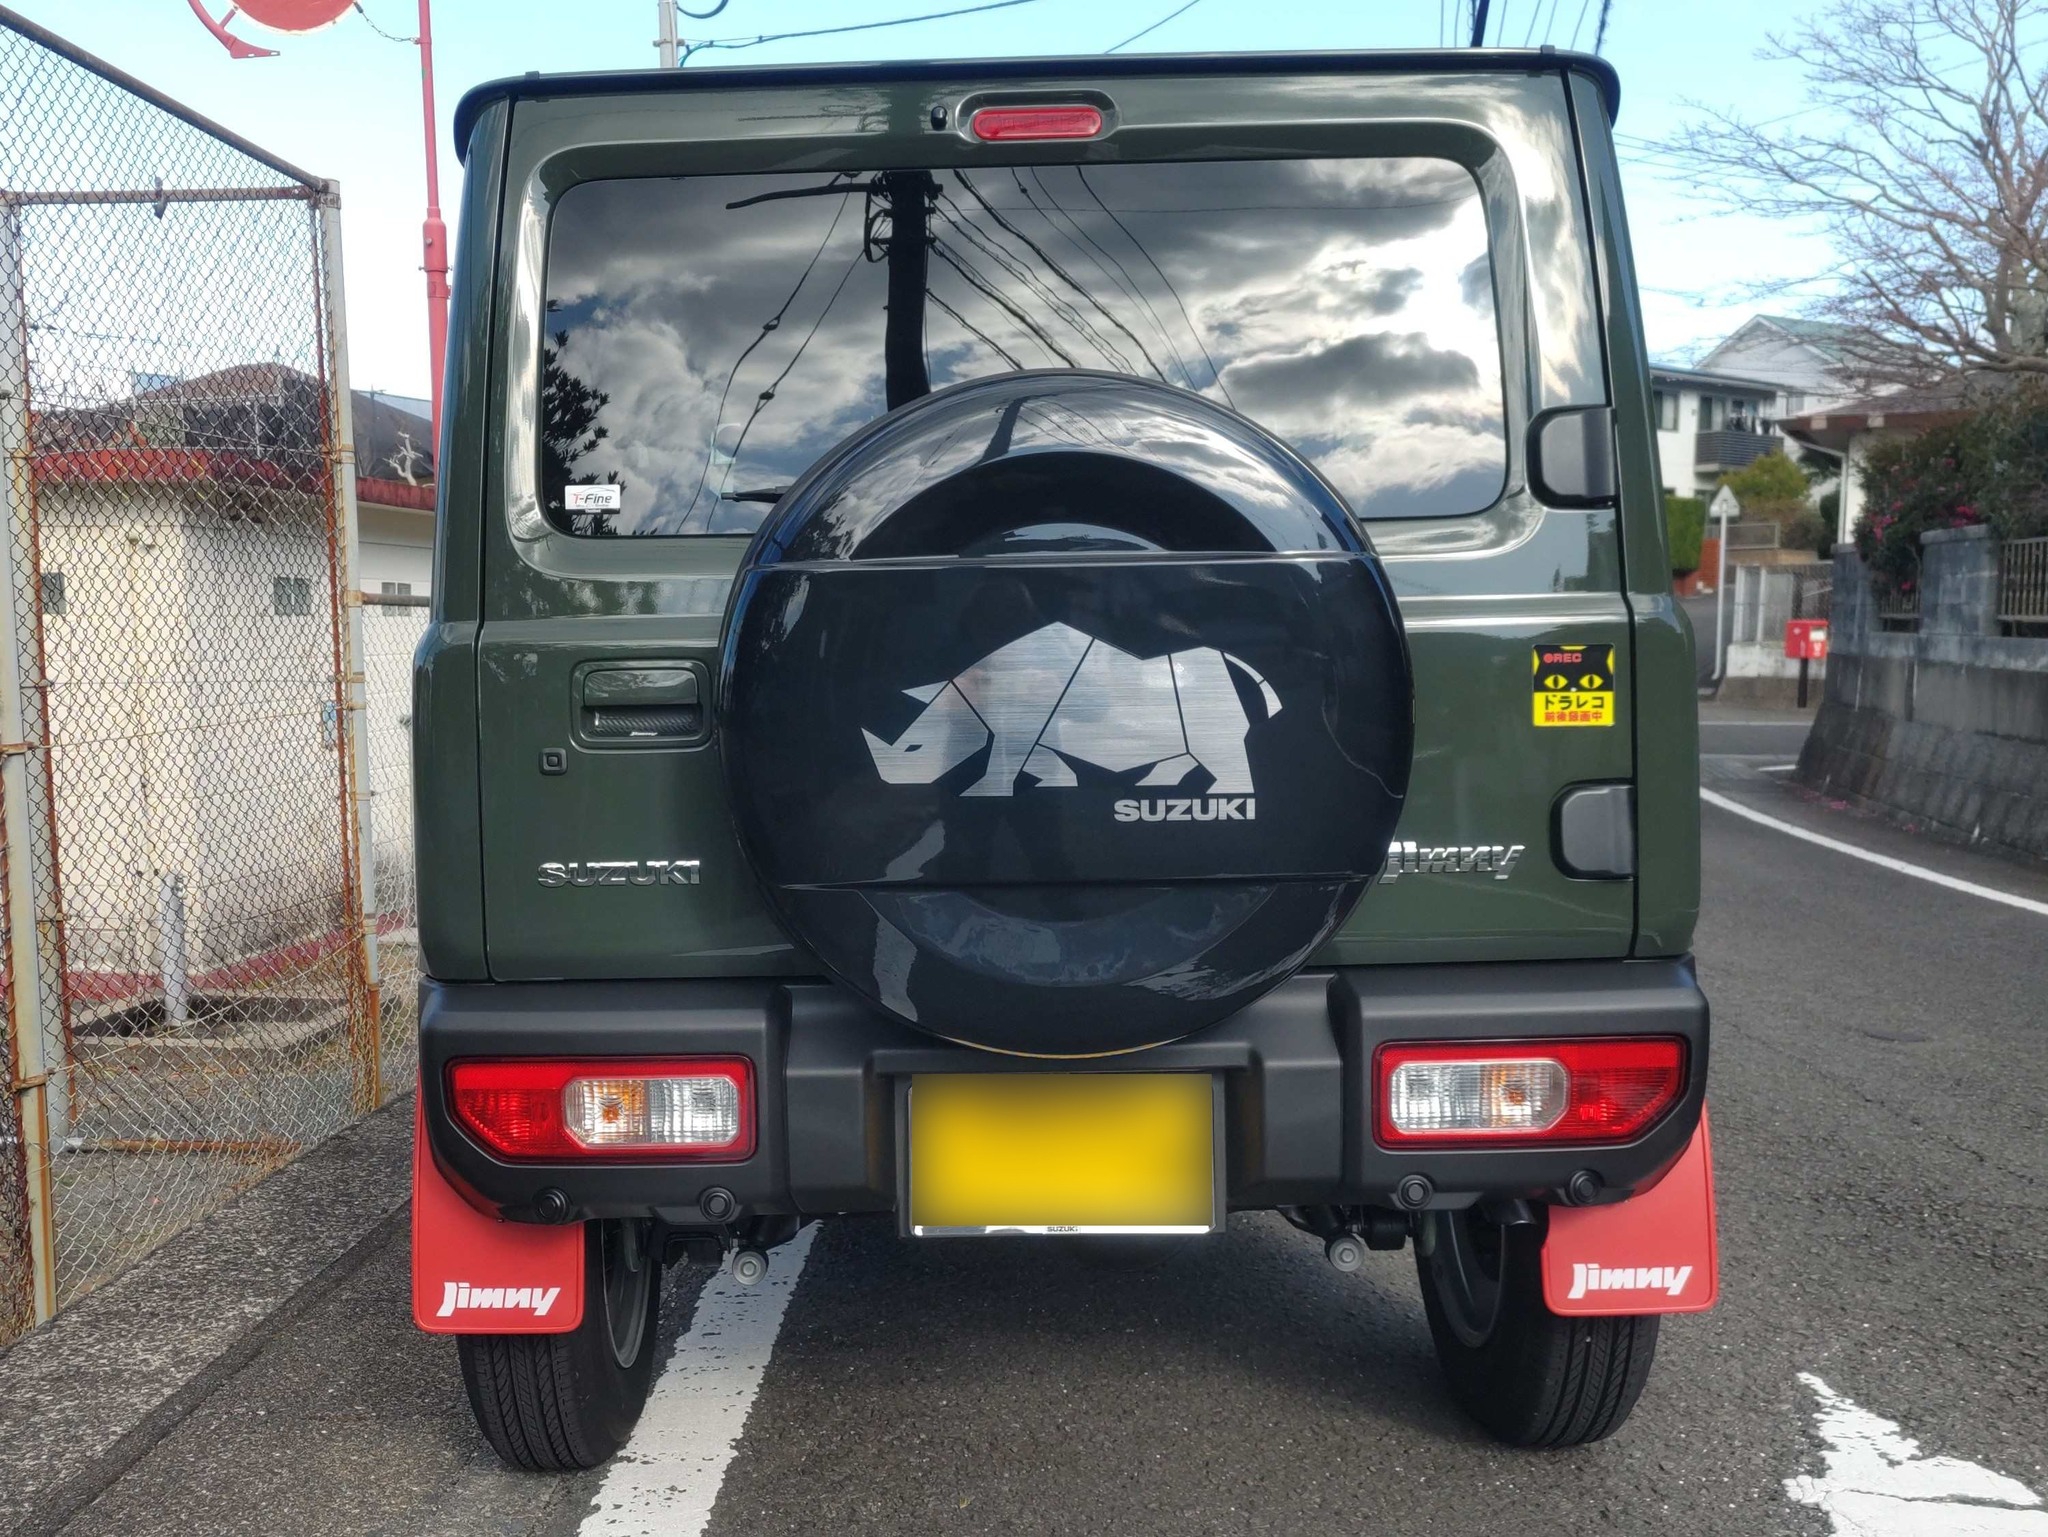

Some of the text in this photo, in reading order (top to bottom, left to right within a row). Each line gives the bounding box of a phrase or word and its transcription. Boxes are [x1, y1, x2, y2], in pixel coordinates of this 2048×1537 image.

[572, 493, 612, 504] T-Fine
[1553, 653, 1582, 663] REC
[1545, 695, 1605, 710] ドラレコ
[1113, 798, 1256, 822] SUZUKI
[538, 860, 700, 888] SUZUKI
[1567, 1263, 1693, 1299] Jimny
[436, 1281, 561, 1317] Jimny
